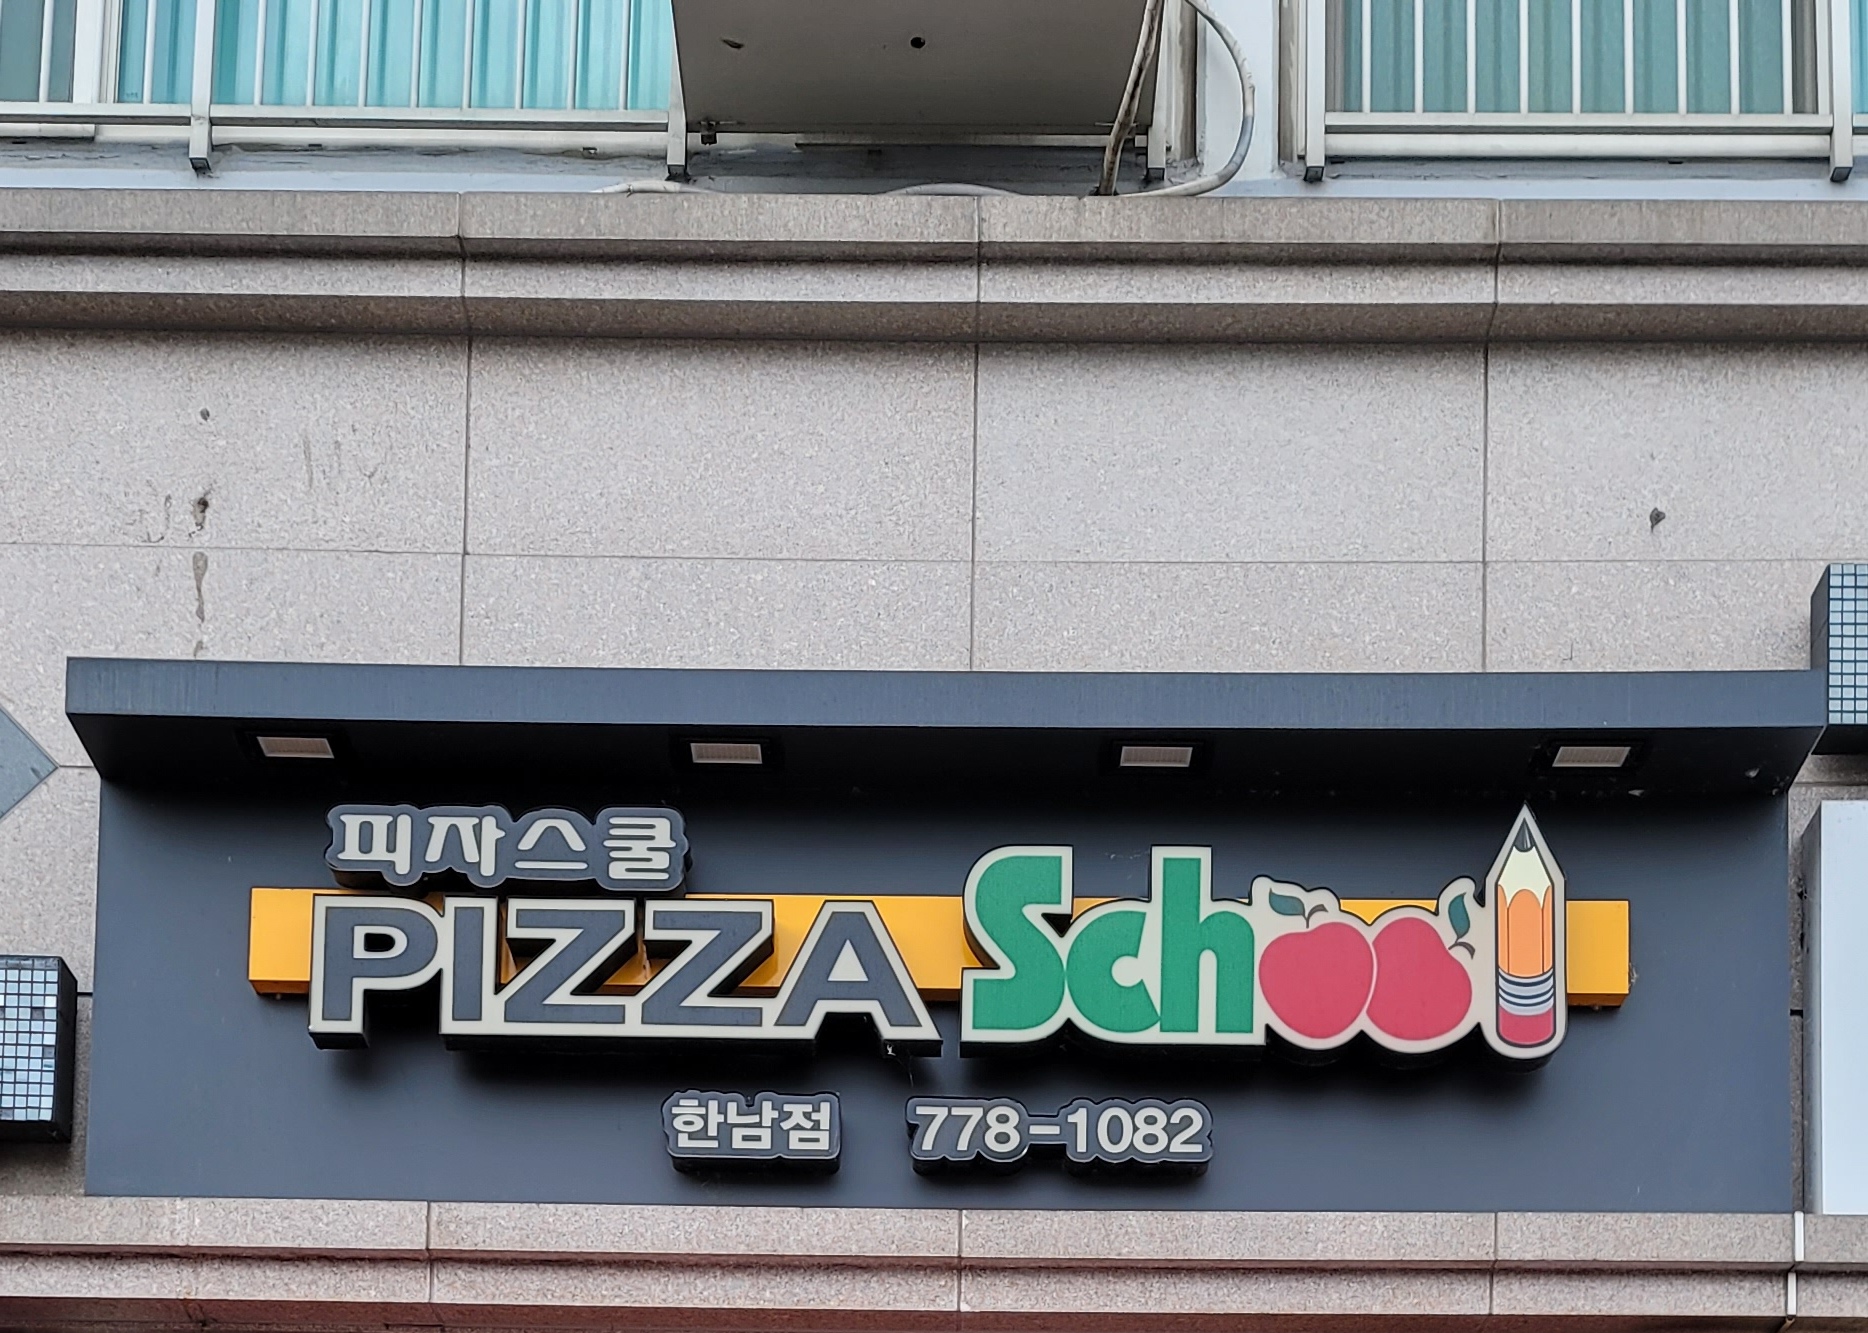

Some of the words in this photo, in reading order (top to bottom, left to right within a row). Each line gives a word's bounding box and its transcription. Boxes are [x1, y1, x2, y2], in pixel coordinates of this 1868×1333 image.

[336, 813, 677, 882] 피자스쿨
[310, 893, 942, 1042] PIZZA
[961, 803, 1567, 1060] School
[670, 1098, 832, 1150] 한남점
[914, 1105, 1204, 1153] 778-1082
